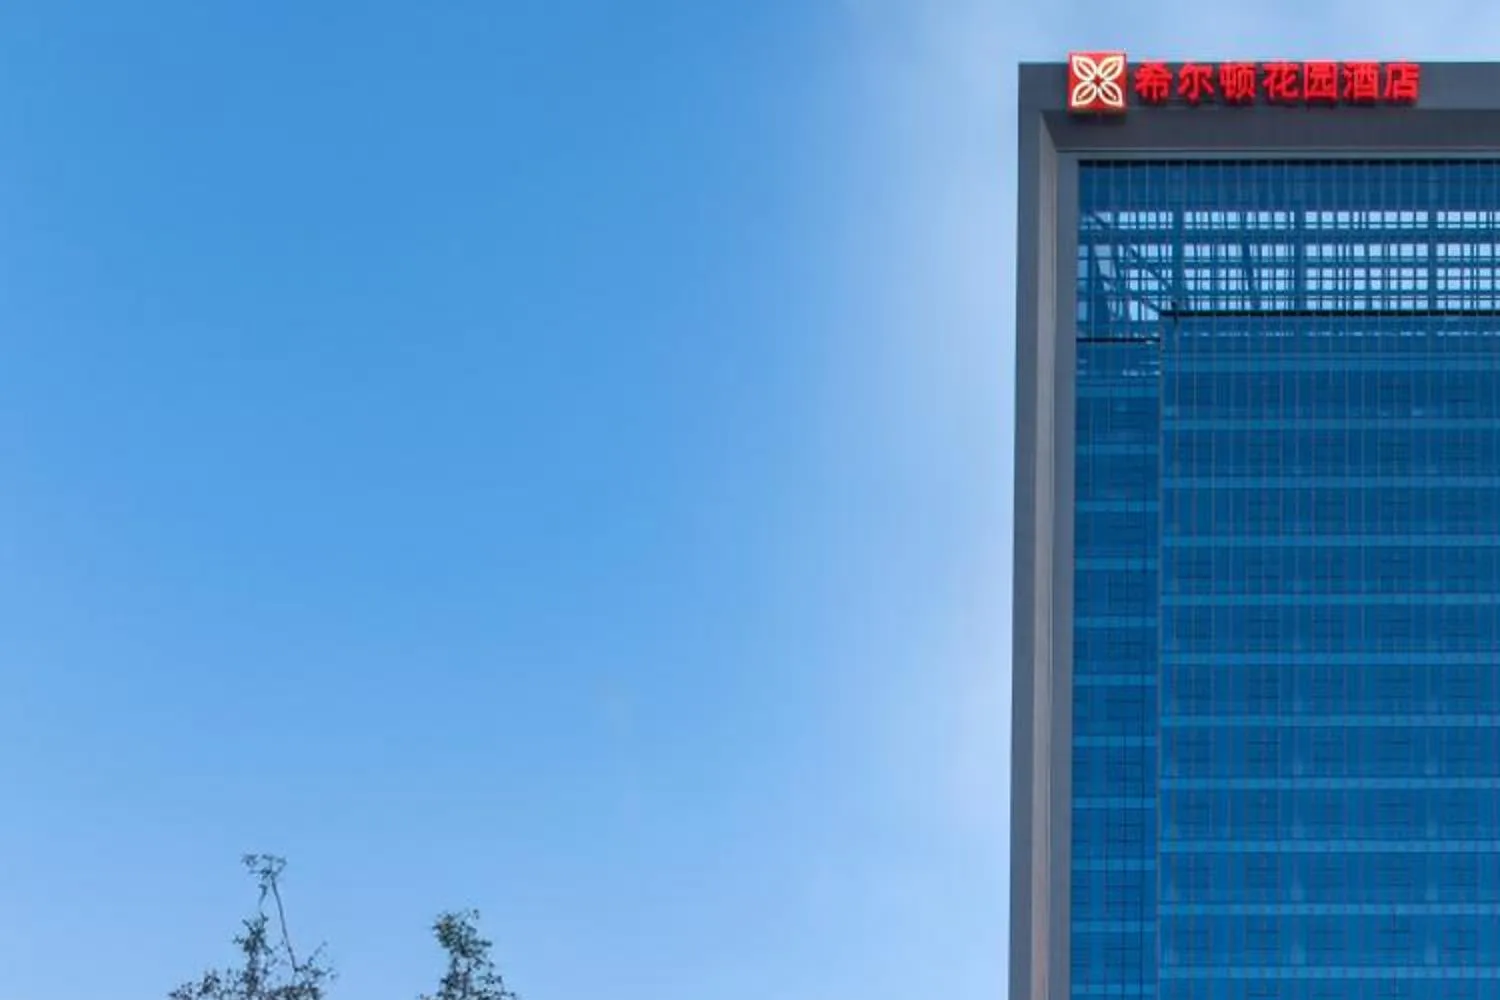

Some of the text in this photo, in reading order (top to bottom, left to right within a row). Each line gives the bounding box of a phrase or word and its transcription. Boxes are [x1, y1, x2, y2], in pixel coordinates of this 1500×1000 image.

[1134, 59, 1421, 101] 希尔顿花园酒店
